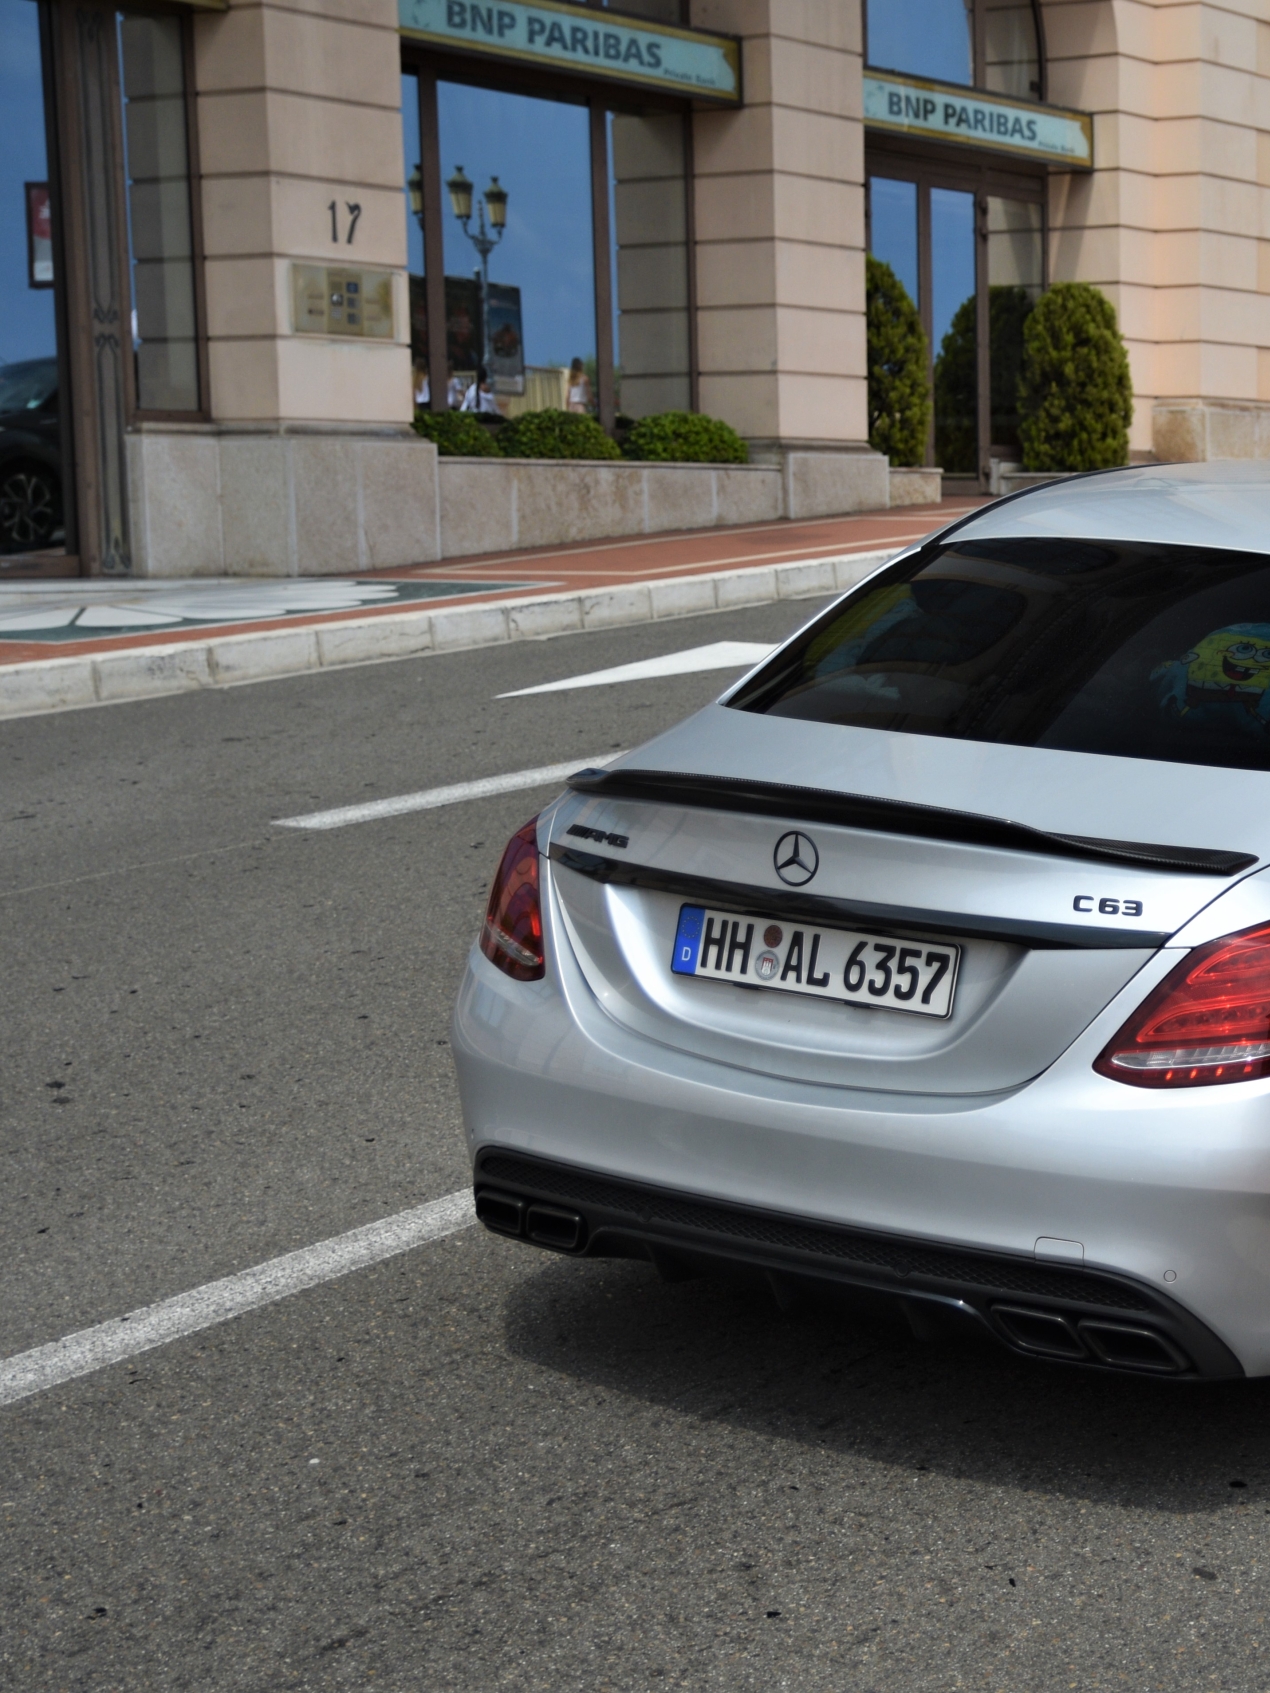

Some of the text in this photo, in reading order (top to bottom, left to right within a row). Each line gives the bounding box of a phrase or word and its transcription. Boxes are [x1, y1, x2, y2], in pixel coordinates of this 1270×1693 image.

[446, 0, 662, 69] BNP PARIBAS
[887, 91, 1038, 141] BNP PARIBAS
[328, 200, 362, 244] 17
[577, 825, 630, 848] AMG
[681, 946, 691, 961] D
[700, 917, 950, 1004] HH AL 6357
